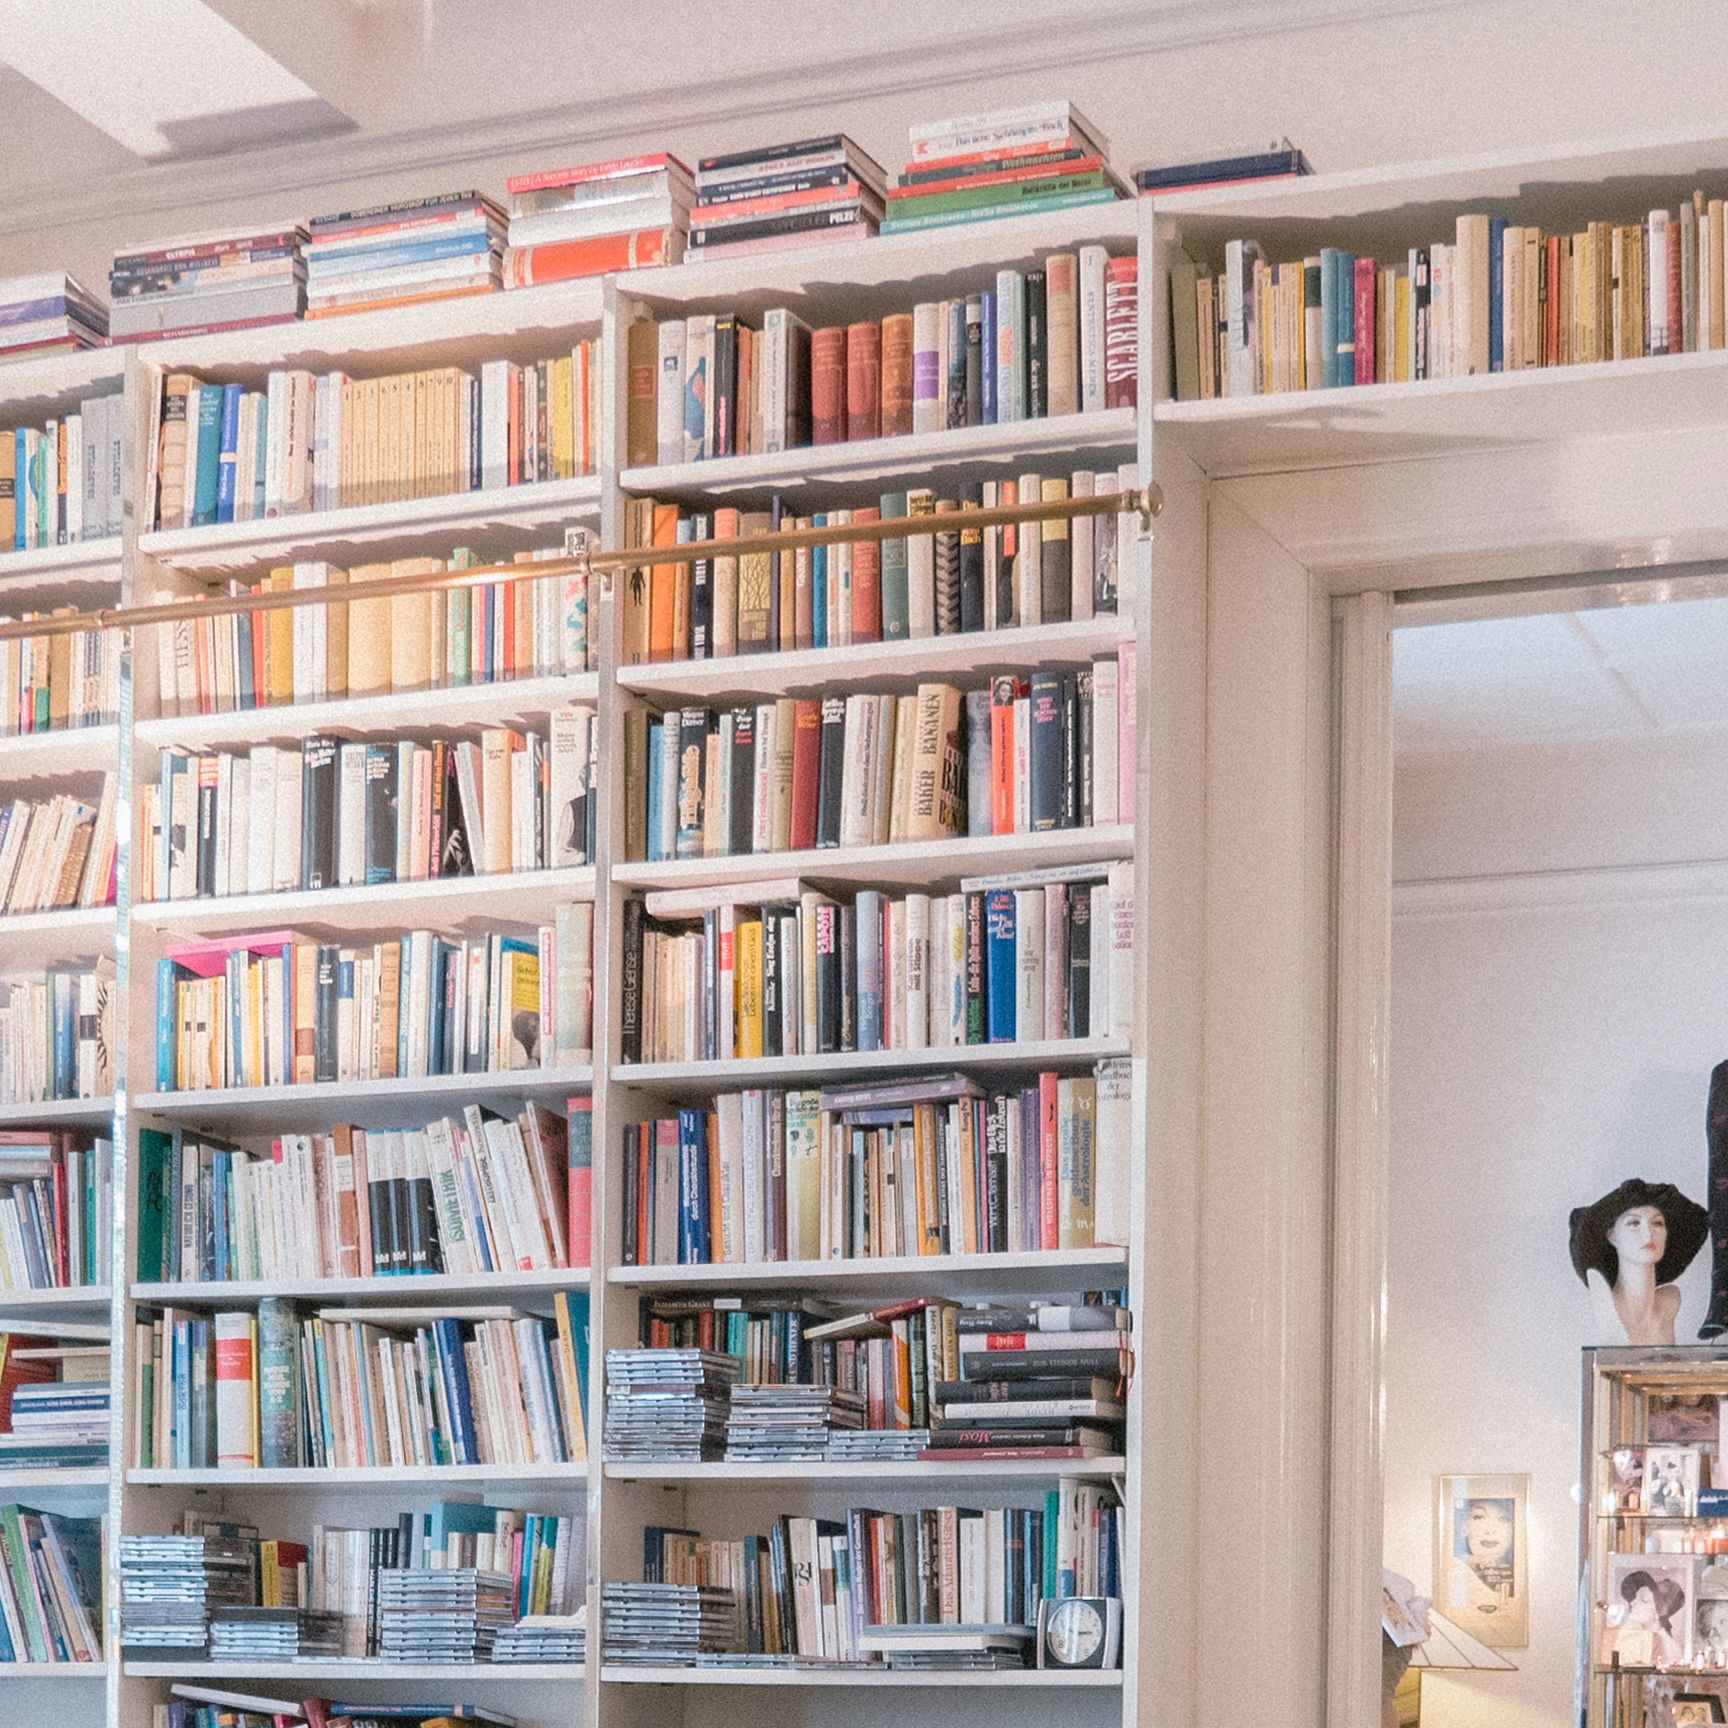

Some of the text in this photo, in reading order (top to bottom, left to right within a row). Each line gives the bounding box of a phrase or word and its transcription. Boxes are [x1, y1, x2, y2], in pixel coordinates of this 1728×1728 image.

[1106, 281, 1140, 382] SCARLETT
[917, 693, 941, 817] BAKER BANANEN
[621, 994, 640, 1036] Therese
[1060, 1117, 1071, 1180] Das große
[1069, 1112, 1080, 1196] goldene Buch
[1079, 1119, 1091, 1207] der Astrologie
[440, 1169, 466, 1242] ISOMETRIK
[942, 1592, 954, 1615] Das
